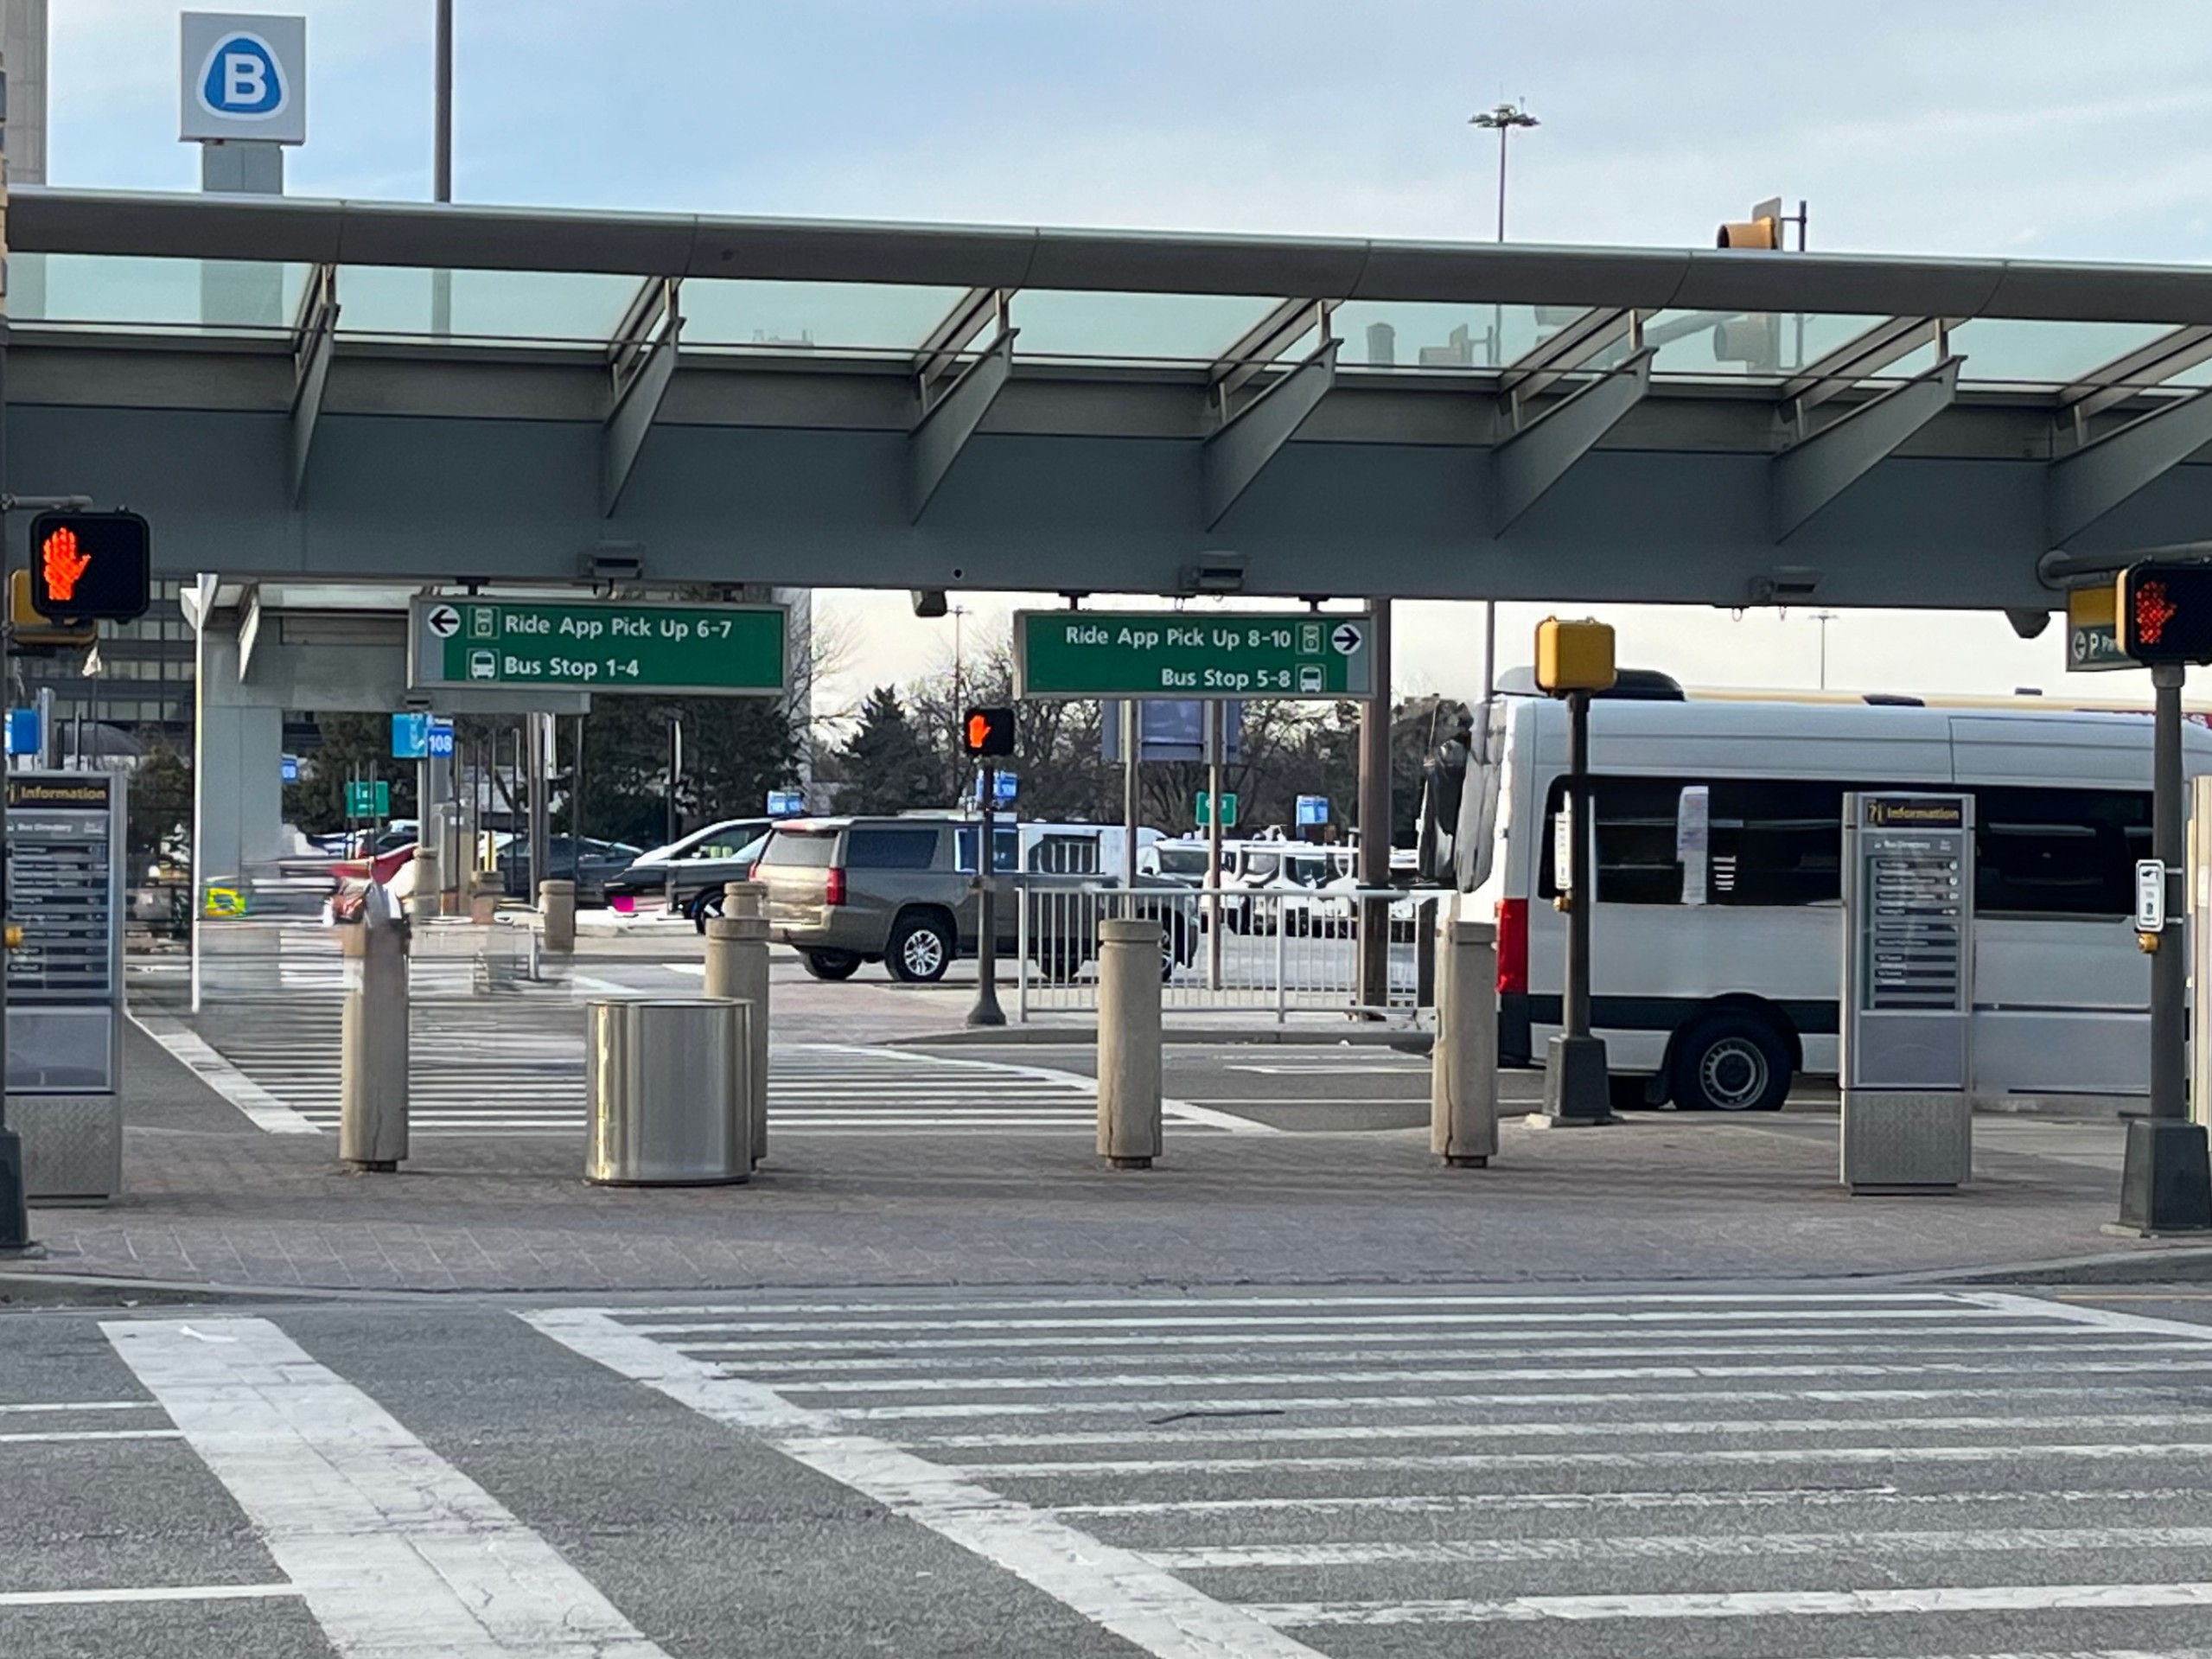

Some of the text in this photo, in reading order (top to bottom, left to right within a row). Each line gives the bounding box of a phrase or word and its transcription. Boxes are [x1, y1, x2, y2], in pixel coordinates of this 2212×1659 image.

[224, 53, 267, 105] B
[505, 614, 732, 642] Ride App Pick Up 6-7
[1066, 625, 1291, 651] Ride App Pick Up 8-10
[504, 656, 640, 681] Bus Stop 1-4
[1162, 667, 1291, 691] Bus Stop 5-8
[429, 735, 452, 752] 108
[21, 785, 106, 800] Information
[1887, 807, 1960, 820] Information
